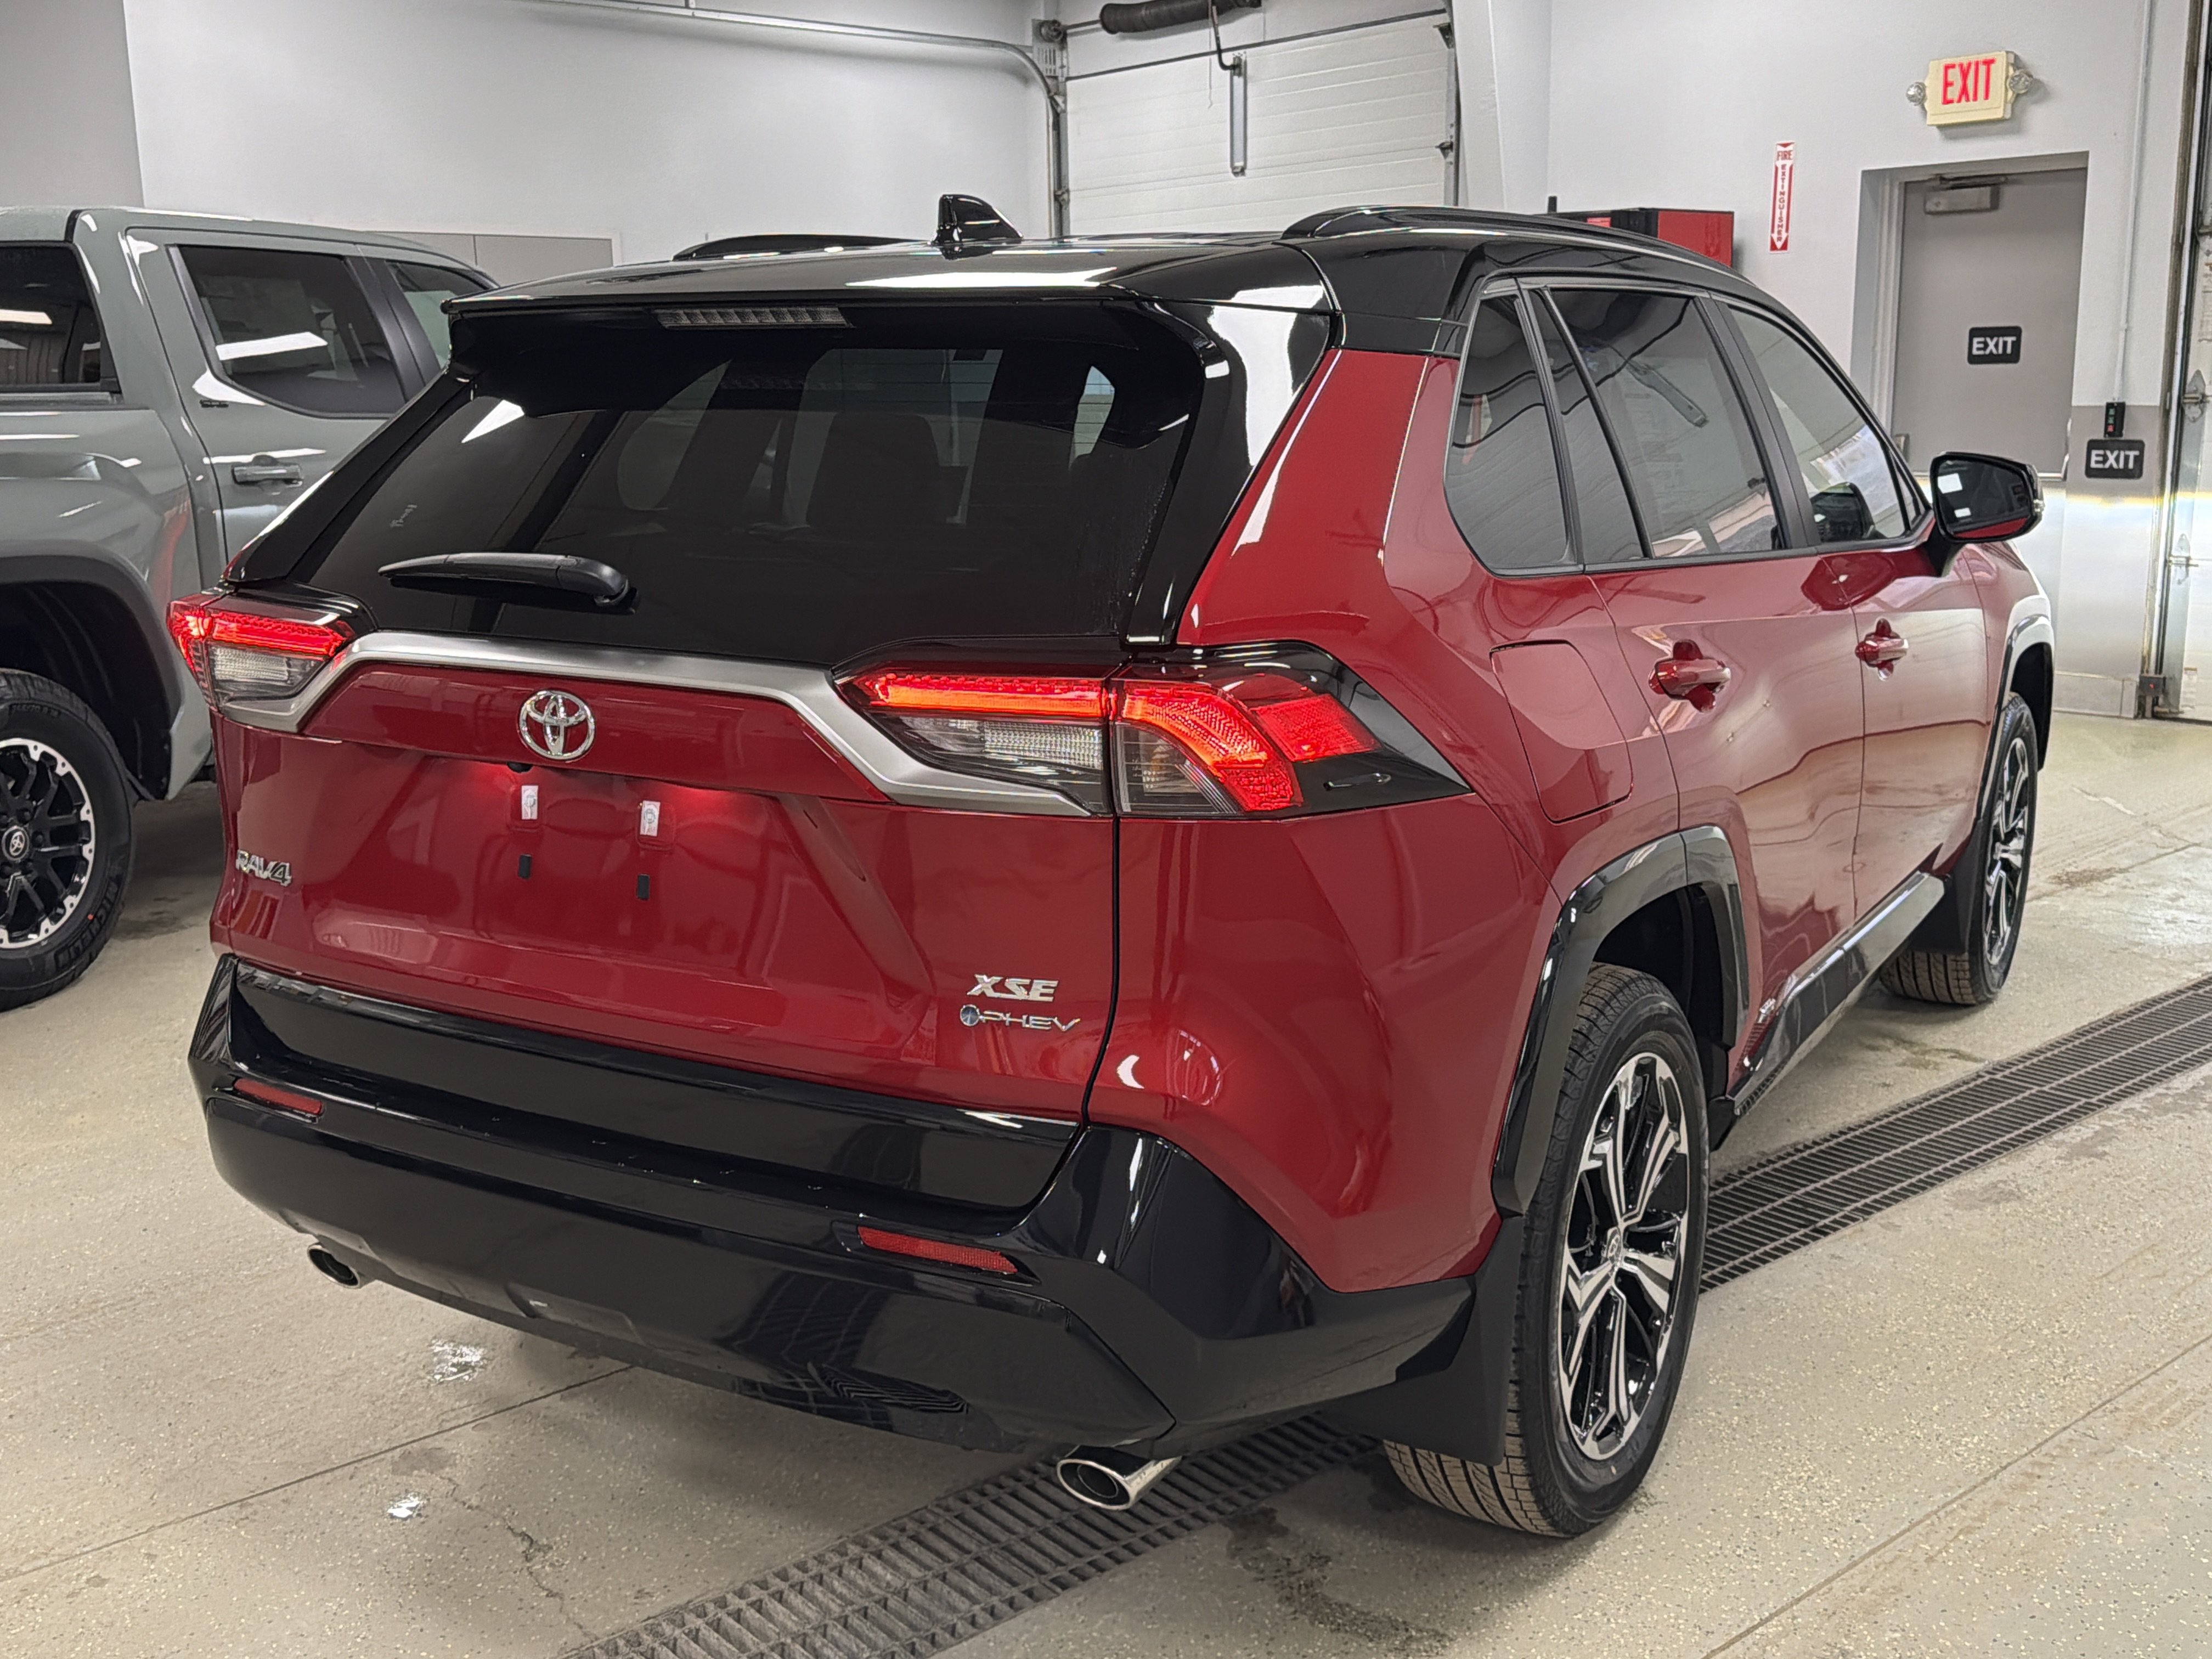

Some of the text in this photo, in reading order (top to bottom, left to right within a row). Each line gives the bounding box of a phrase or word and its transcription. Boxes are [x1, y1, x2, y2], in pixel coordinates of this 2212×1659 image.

[1942, 57, 1996, 105] EXIT
[1776, 150, 1793, 161] FIRE
[1776, 164, 1787, 242] EXTINGUISHER
[1972, 336, 2017, 356] EXIT
[2090, 449, 2140, 470] EXIT
[235, 849, 292, 887] RAV4
[966, 974, 1059, 1002] XSE
[979, 1009, 1081, 1032] PHEV
